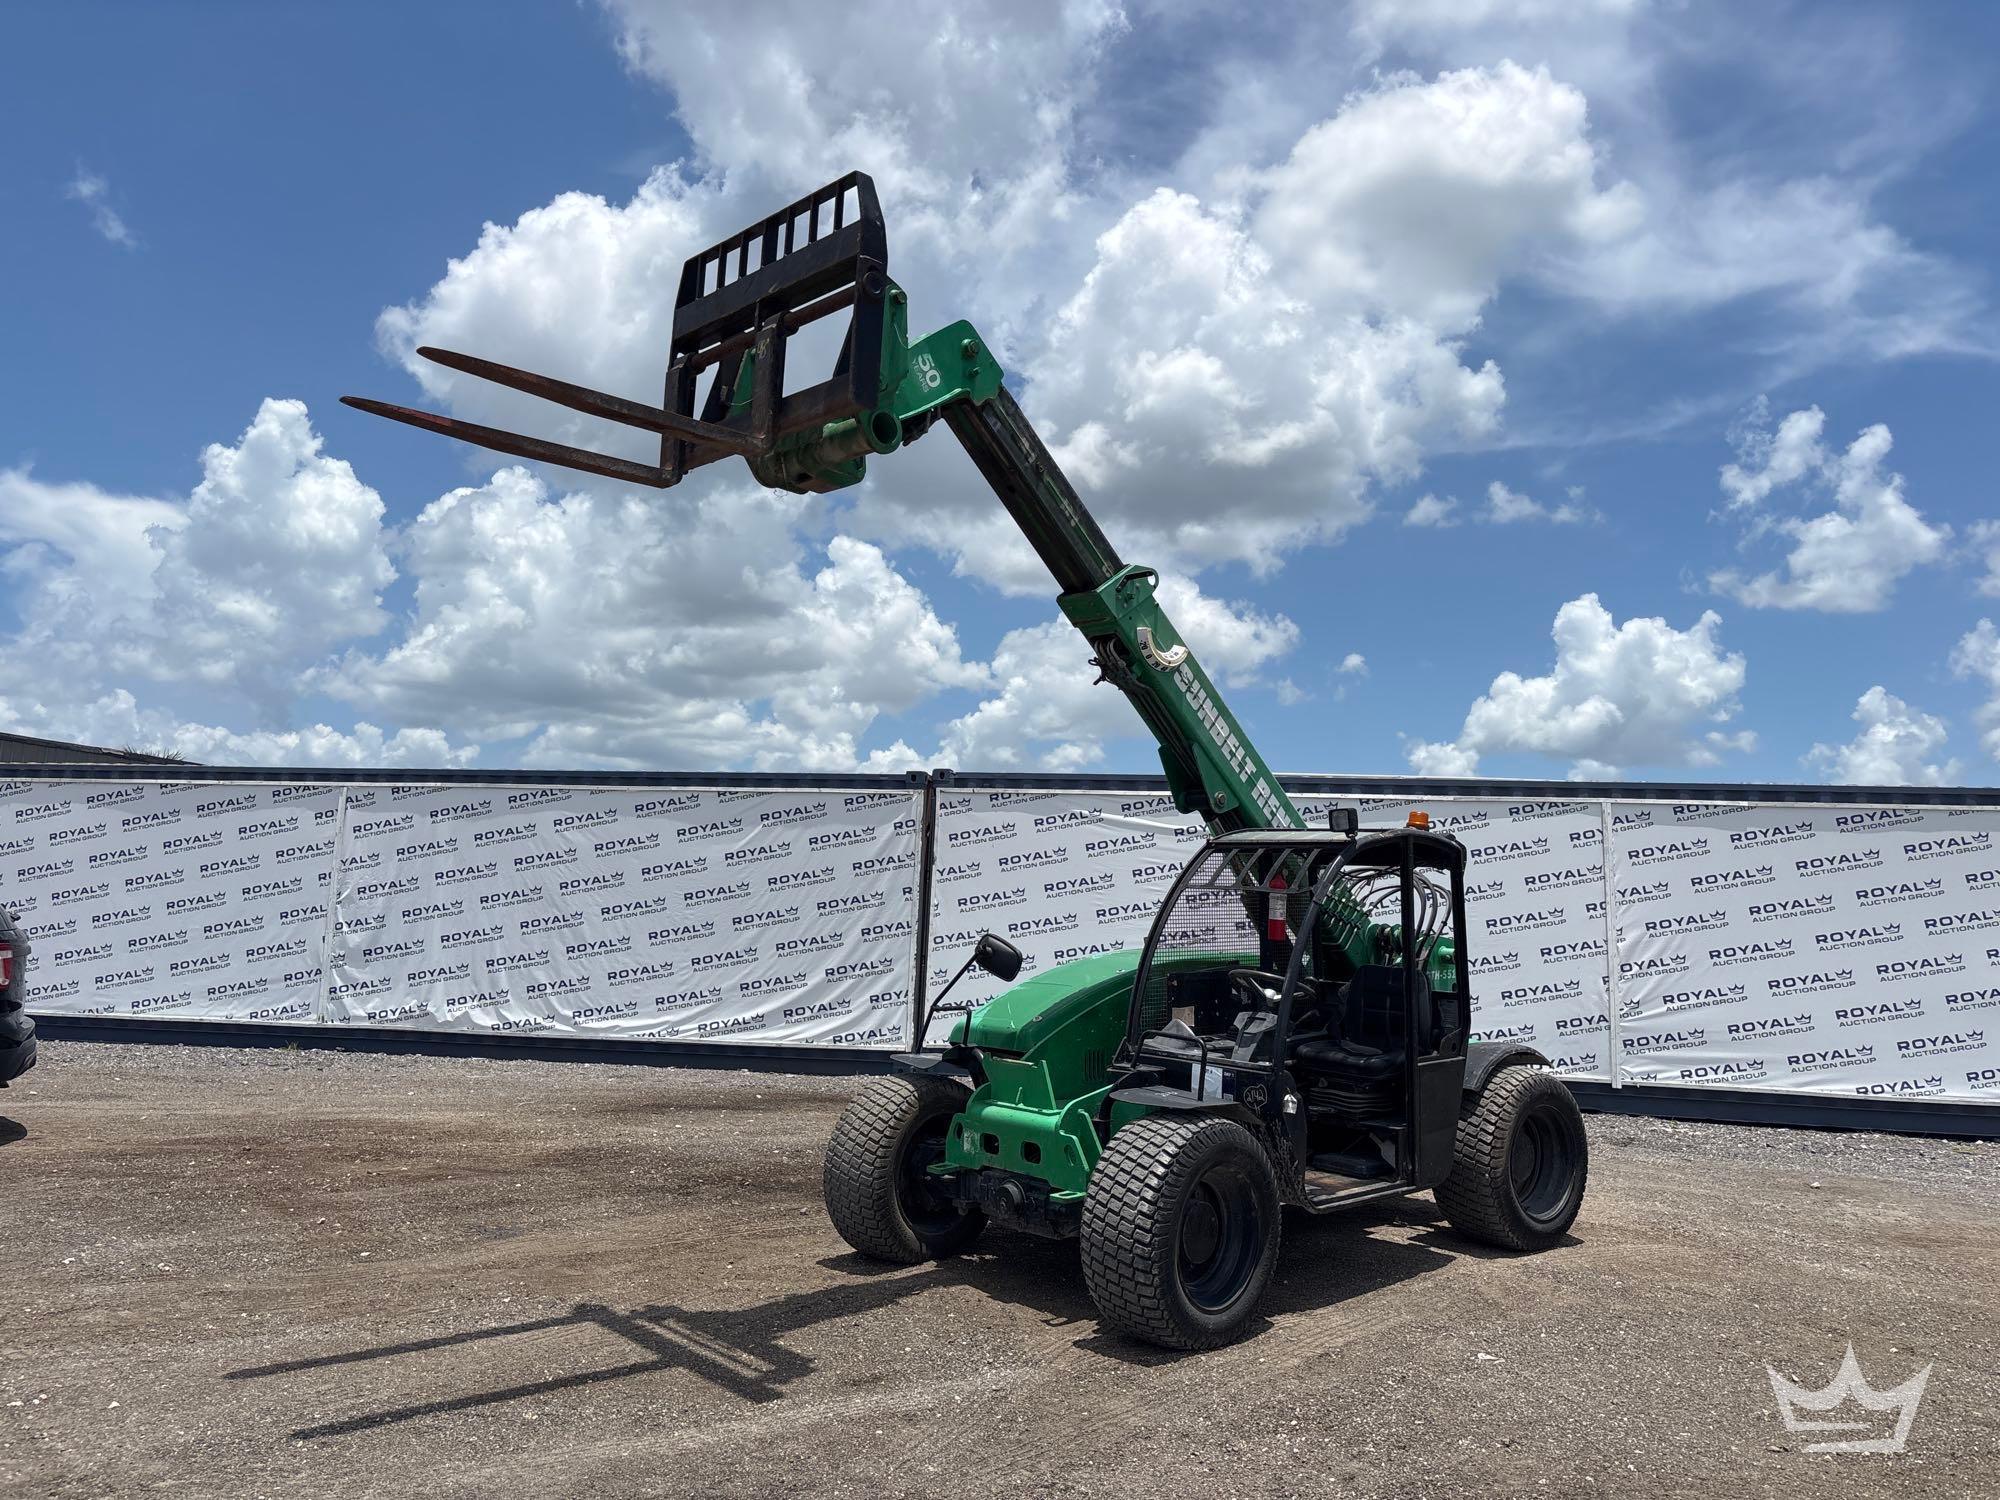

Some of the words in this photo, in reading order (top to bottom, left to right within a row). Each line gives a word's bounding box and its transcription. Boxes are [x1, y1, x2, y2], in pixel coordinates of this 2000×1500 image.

[918, 353, 941, 388] 50
[1174, 662, 1257, 783] SUNBELT
[86, 789, 132, 804] ROYAL
[87, 799, 119, 810] AUCTION
[120, 794, 145, 804] GROUP
[196, 797, 244, 813] ROYAL
[197, 808, 230, 819] AUCTION
[231, 803, 257, 812] GROUP
[430, 803, 478, 819] ROYAL
[431, 814, 465, 825] AUCTION
[465, 809, 492, 818] GROUP
[553, 811, 604, 827] ROYAL
[352, 818, 401, 834] ROYAL
[354, 829, 387, 840] AUCTION
[388, 824, 414, 834] GROUP
[554, 823, 590, 834] AUCTION
[590, 818, 618, 827] GROUP
[677, 821, 729, 837] ROYAL
[948, 826, 1002, 842] ROYAL
[1730, 825, 1796, 843] ROYAL
[678, 833, 714, 844] AUCTION
[715, 827, 744, 837] GROUP
[808, 830, 862, 846] ROYAL
[950, 838, 987, 848] AUCTION
[988, 832, 1018, 842] GROUP
[1733, 838, 1778, 850] AUCTION
[1779, 832, 1816, 843] GROUP
[810, 842, 847, 852] AUCTION
[848, 836, 877, 846] GROUP
[1085, 836, 1141, 852] ROYAL
[1087, 848, 1126, 858] AUCTION
[1126, 842, 1157, 852] GROUP
[1470, 841, 1532, 858] ROYAL
[1628, 842, 1692, 860] ROYAL
[1903, 836, 1972, 854] ROYAL
[1473, 854, 1516, 866] AUCTION
[1517, 848, 1551, 858] GROUP
[1631, 855, 1674, 867] AUCTION
[1676, 849, 1711, 860] GROUP
[1907, 850, 1954, 862] AUCTION
[1955, 844, 1993, 854] GROUP
[17, 862, 62, 877] ROYAL
[1795, 853, 1863, 871] ROYAL
[1799, 866, 1845, 878] AUCTION
[1846, 860, 1884, 871] GROUP
[18, 873, 48, 883] AUCTION
[49, 868, 74, 877] GROUP
[125, 872, 172, 887] ROYAL
[559, 875, 611, 890] ROYAL
[1690, 869, 1756, 887] ROYAL
[125, 883, 158, 893] AUCTION
[159, 878, 185, 887] GROUP
[242, 880, 290, 896] ROYAL
[357, 880, 407, 895] ROYAL
[560, 886, 596, 897] AUCTION
[597, 881, 625, 891] GROUP
[1694, 882, 1738, 894] AUCTION
[1740, 876, 1776, 887] GROUP
[1856, 882, 1925, 900] ROYAL
[243, 892, 276, 902] AUCTION
[276, 886, 303, 896] GROUP
[358, 891, 393, 901] AUCTION
[393, 886, 420, 895] GROUP
[480, 889, 530, 904] ROYAL
[957, 891, 1012, 907] ROYAL
[1859, 895, 1906, 907] AUCTION
[1908, 890, 1945, 900] GROUP
[481, 900, 516, 911] AUCTION
[516, 895, 544, 905] GROUP
[817, 894, 870, 911] ROYAL
[818, 906, 855, 918] AUCTION
[856, 901, 886, 911] GROUP
[959, 903, 996, 914] AUCTION
[997, 898, 1027, 907] GROUP
[1748, 898, 1816, 916] ROYAL
[732, 910, 785, 926] ROYAL
[1486, 912, 1548, 929] ROYAL
[1752, 911, 1797, 923] AUCTION
[1799, 906, 1836, 916] GROUP
[734, 921, 770, 932] AUCTION
[771, 916, 800, 926] GROUP
[1489, 924, 1531, 936] AUCTION
[1532, 918, 1567, 929] GROUP
[1645, 914, 1710, 932] ROYAL
[1648, 927, 1692, 939] AUCTION
[1694, 921, 1729, 932] GROUP
[648, 924, 701, 940] ROYAL
[649, 936, 686, 947] AUCTION
[686, 931, 716, 941] GROUP
[1815, 927, 1884, 944] ROYAL
[246, 942, 294, 958] ROYAL
[362, 942, 412, 958] ROYAL
[1708, 942, 1776, 960] ROYAL
[1819, 940, 1865, 952] AUCTION
[1867, 935, 1904, 945] GROUP
[170, 956, 218, 972] ROYAL
[247, 953, 280, 964] AUCTION
[281, 948, 308, 958] GROUP
[364, 953, 398, 964] AUCTION
[399, 948, 425, 958] GROUP
[1712, 956, 1757, 967] AUCTION
[1759, 950, 1796, 960] GROUP
[170, 967, 204, 978] AUCTION
[204, 962, 231, 972] GROUP
[825, 961, 879, 977] ROYAL
[1876, 957, 1946, 975] ROYAL
[1880, 971, 1927, 982] AUCTION
[1928, 965, 1966, 976] GROUP
[95, 970, 142, 985] ROYAL
[95, 981, 128, 991] AUCTION
[128, 976, 155, 985] GROUP
[826, 973, 864, 984] AUCTION
[864, 967, 894, 978] GROUP
[1768, 973, 1836, 990] ROYAL
[526, 979, 577, 994] ROYAL
[740, 976, 793, 992] ROYAL
[741, 988, 778, 998] AUCTION
[778, 982, 808, 992] GROUP
[1501, 983, 1564, 1000] ROYAL
[1771, 986, 1817, 998] AUCTION
[1819, 981, 1856, 991] GROUP
[528, 990, 562, 1001] AUCTION
[563, 985, 591, 995] GROUP
[655, 990, 708, 1006] ROYAL
[1504, 996, 1547, 1008] AUCTION
[1548, 991, 1583, 1001] GROUP
[656, 1002, 693, 1013] AUCTION
[694, 997, 723, 1007] GROUP
[1835, 1002, 1904, 1020] ROYAL
[1727, 1017, 1795, 1034] ROYAL
[1839, 1016, 1885, 1028] AUCTION
[1887, 1010, 1925, 1021] GROUP
[1622, 1032, 1688, 1049] ROYAL
[1731, 1031, 1776, 1042] AUCTION
[1778, 1026, 1815, 1036] GROUP
[1625, 1045, 1670, 1056] AUCTION
[1671, 1040, 1708, 1050] GROUP
[1897, 1034, 1967, 1051] ROYAL
[1901, 1048, 1948, 1059] AUCTION
[1949, 1042, 1987, 1053] GROUP
[1787, 1049, 1856, 1066] ROYAL
[1791, 1062, 1837, 1073] AUCTION
[1839, 1057, 1877, 1067] GROUP
